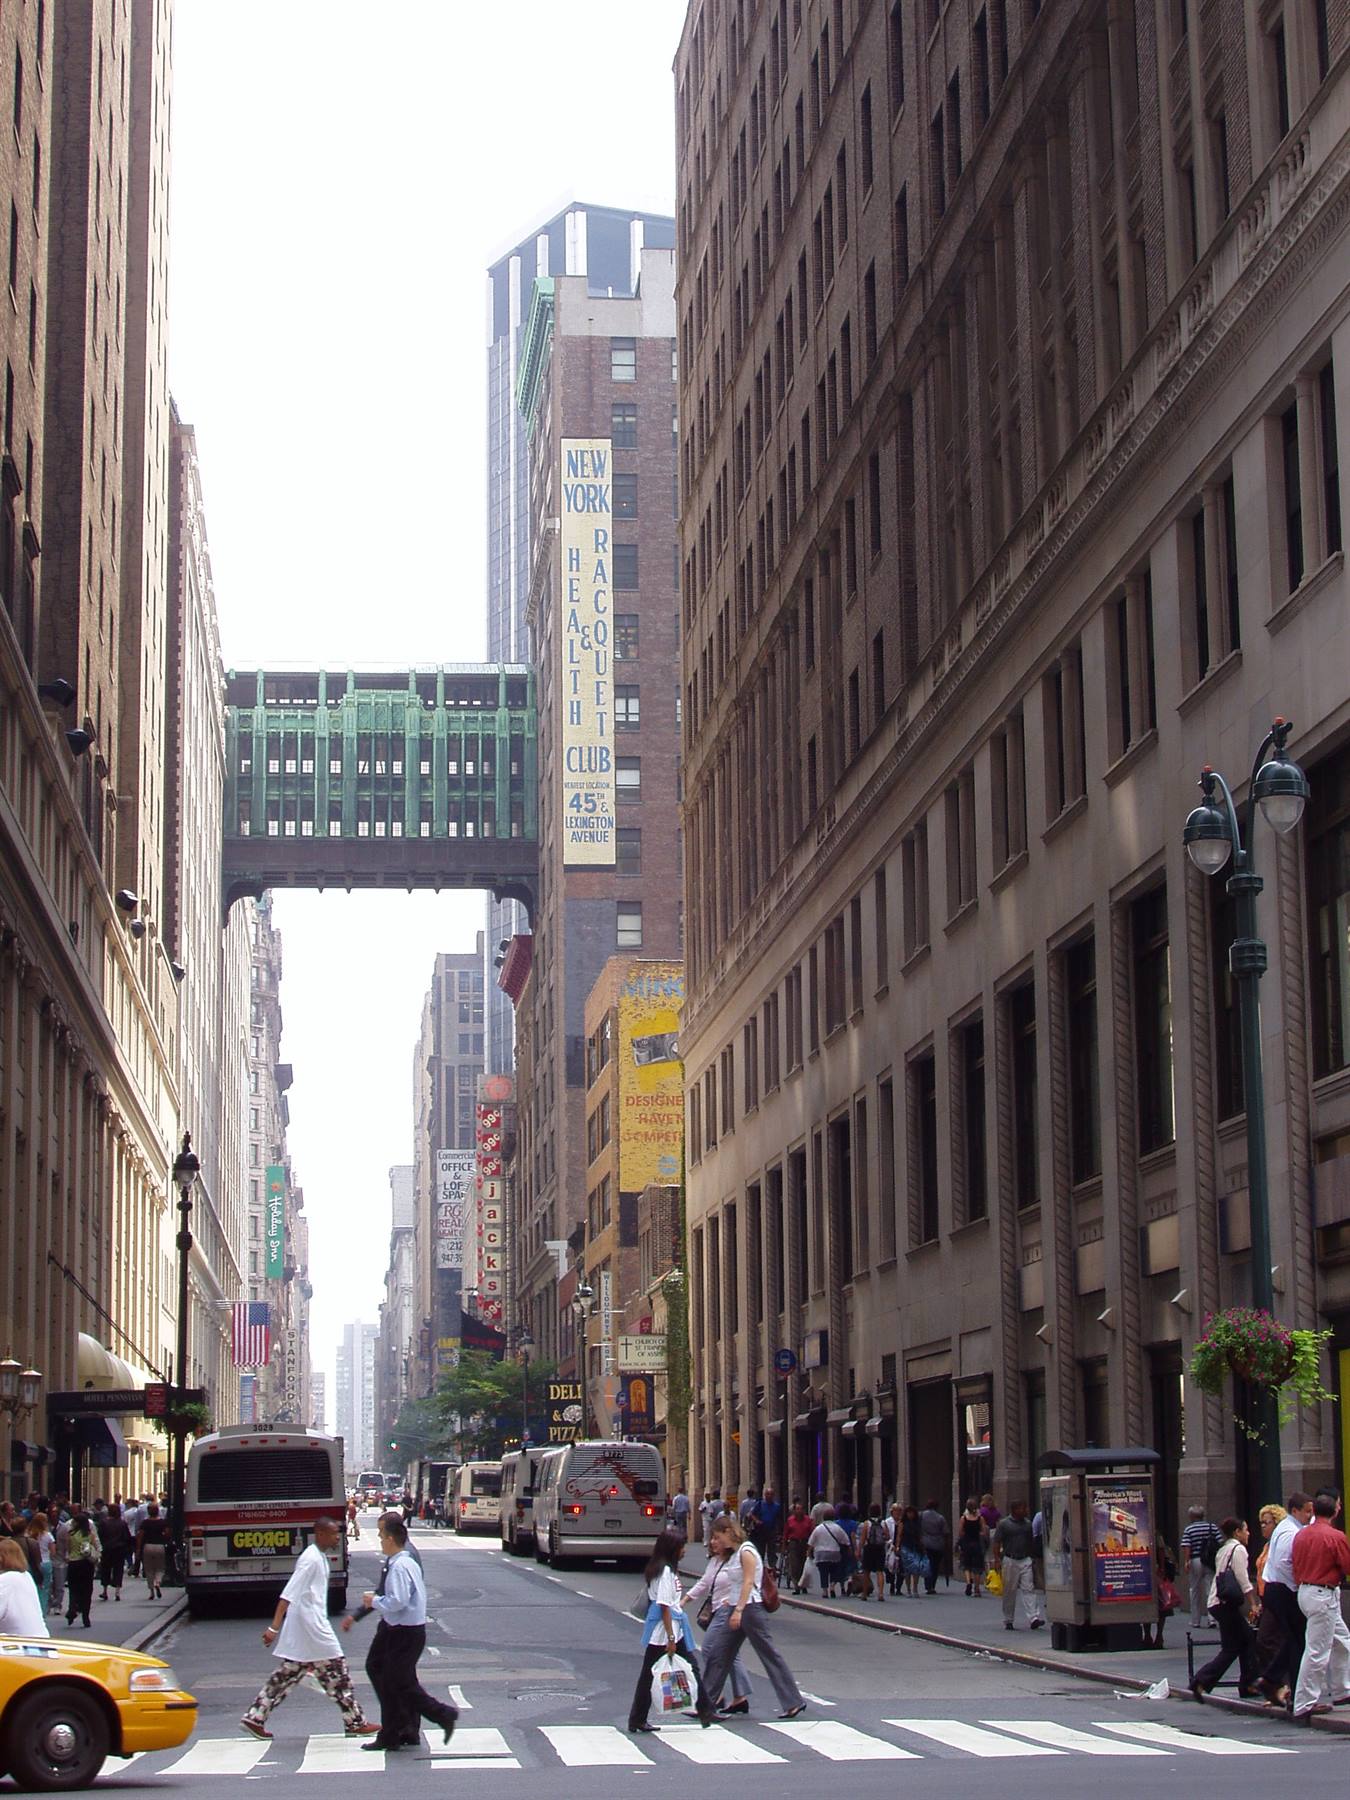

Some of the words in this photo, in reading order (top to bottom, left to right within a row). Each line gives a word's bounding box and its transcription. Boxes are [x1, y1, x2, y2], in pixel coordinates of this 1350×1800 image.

[567, 449, 607, 478] NEW
[563, 483, 610, 513] YORK
[567, 547, 581, 726] HEALTH
[580, 625, 593, 650] &
[593, 528, 608, 737] RACQUET
[566, 746, 611, 773] CLUB
[601, 802, 609, 813] &
[565, 816, 614, 828] LEXINGTON
[571, 831, 608, 842] AVENUE
[438, 1150, 476, 1160] Commercial
[441, 1163, 473, 1171] OFFICE
[453, 1172, 462, 1180] &
[444, 1182, 463, 1190] LOF
[268, 1196, 282, 1237] Holiday
[270, 1240, 280, 1262] Inn
[287, 1331, 296, 1400] STANFORD
[549, 1384, 582, 1400] DELI
[552, 1409, 562, 1422] &
[549, 1426, 583, 1441] PIZZA
[252, 1547, 276, 1555] VODKA
